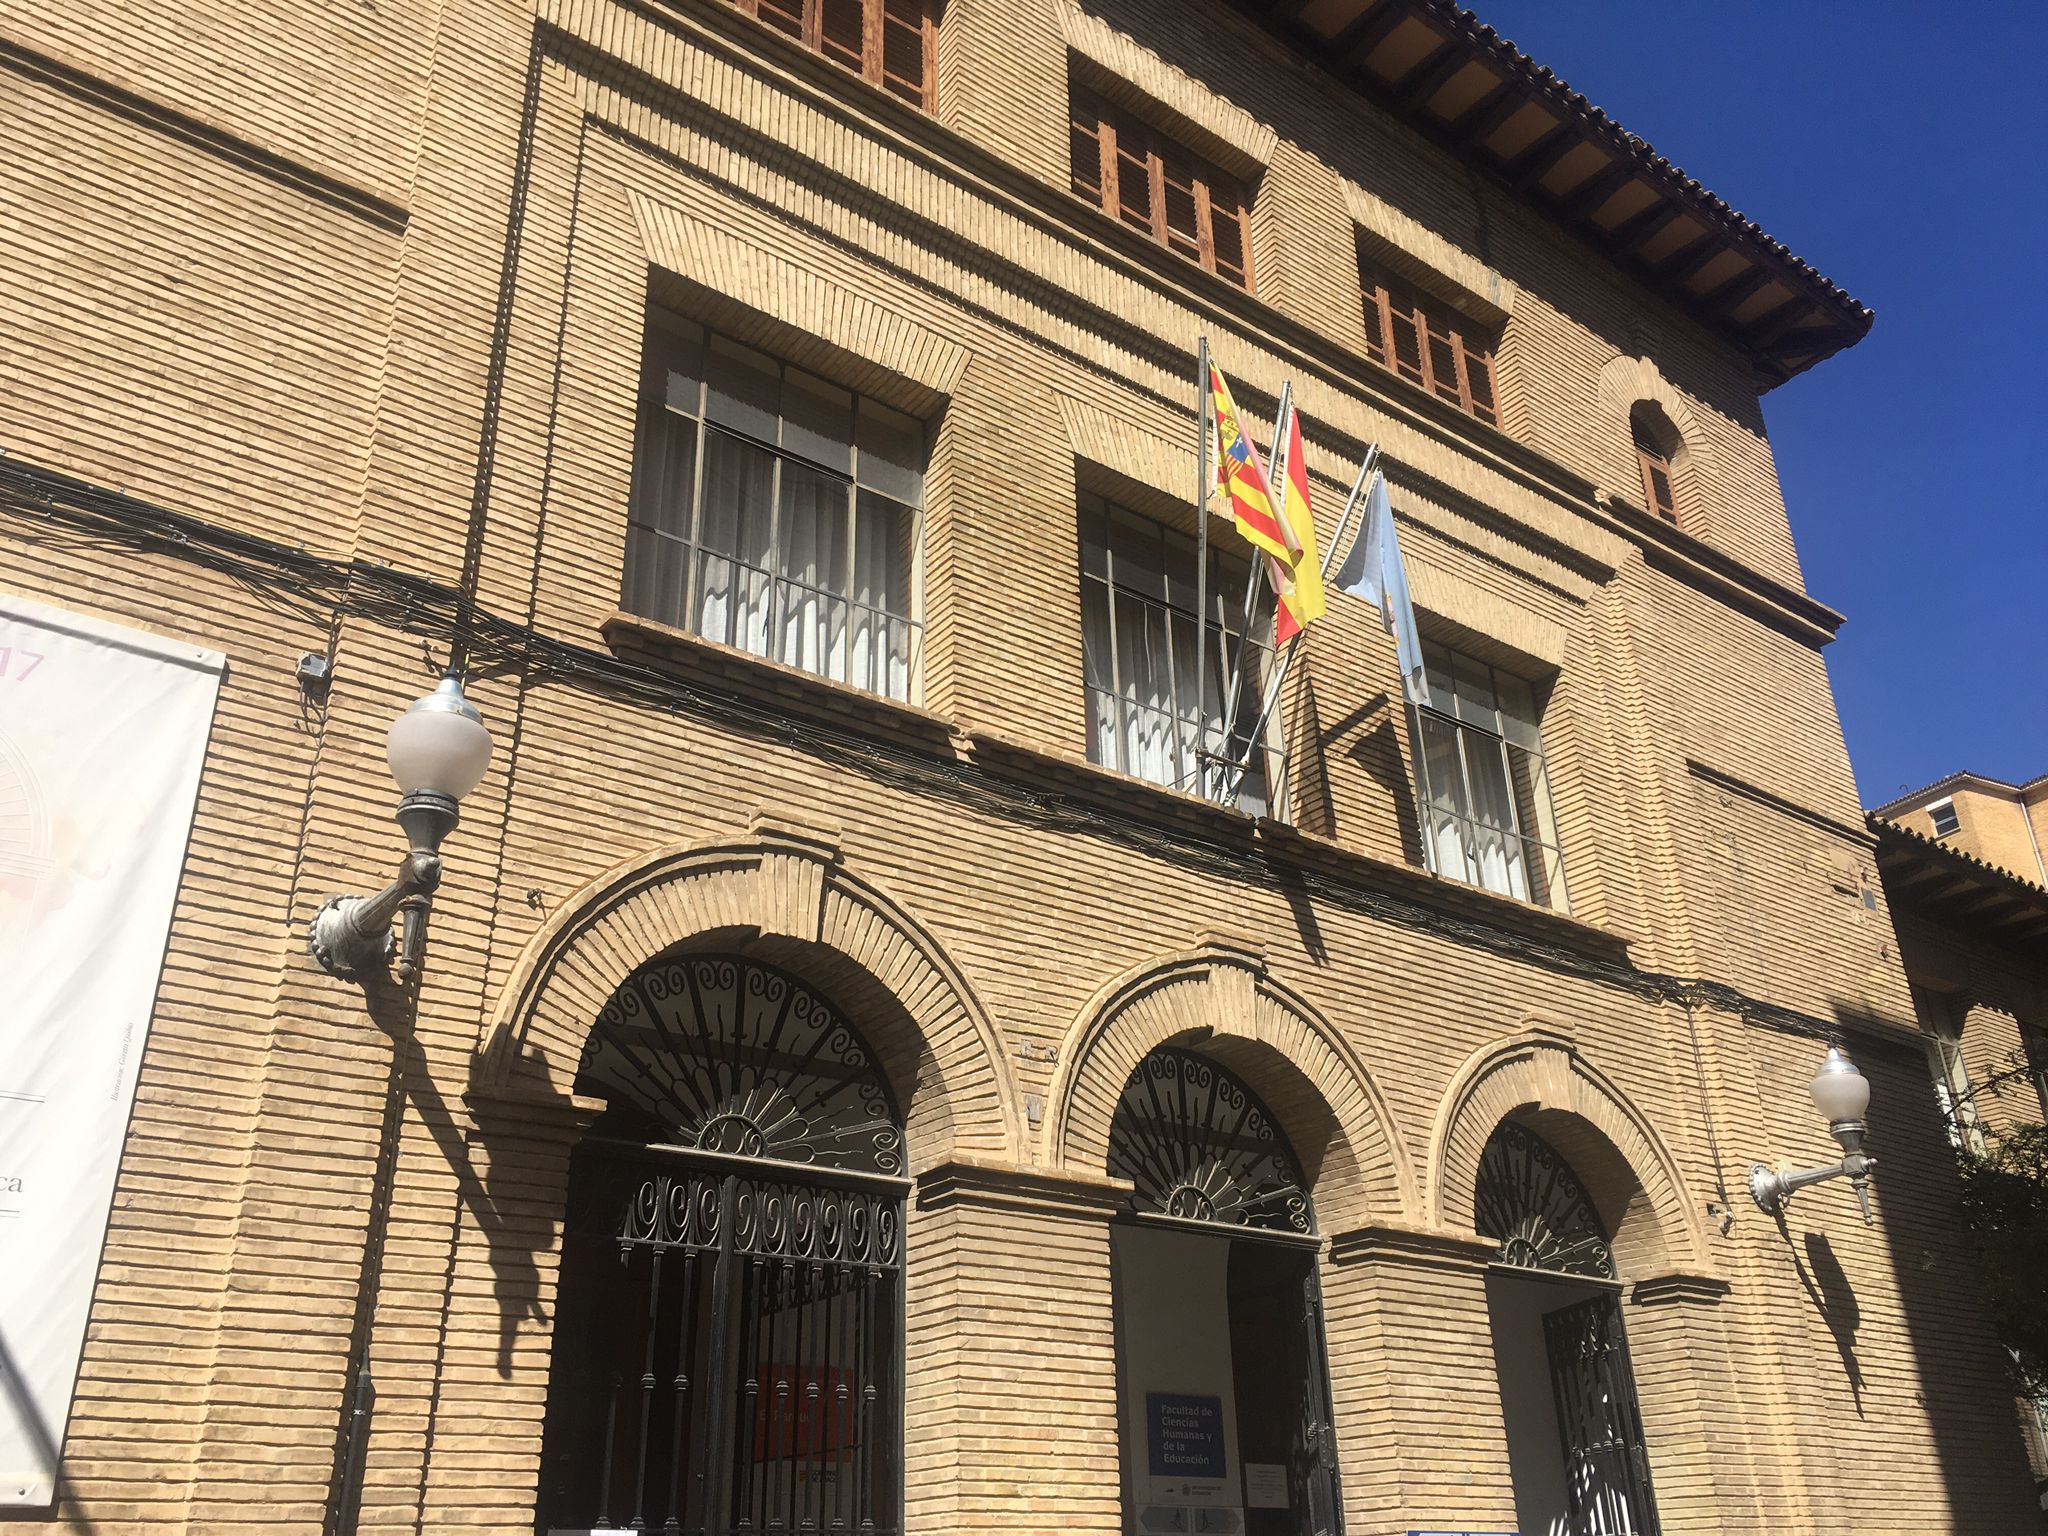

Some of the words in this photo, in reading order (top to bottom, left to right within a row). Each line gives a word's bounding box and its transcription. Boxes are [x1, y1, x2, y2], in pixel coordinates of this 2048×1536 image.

[1161, 1404, 1199, 1416] Facultad
[1201, 1407, 1213, 1417] de
[1161, 1416, 1199, 1428] Ciencias
[1162, 1429, 1205, 1440] Humanas
[1206, 1432, 1213, 1443] y
[1163, 1441, 1174, 1451] de
[1176, 1441, 1185, 1451] la
[1163, 1453, 1210, 1465] Educación
